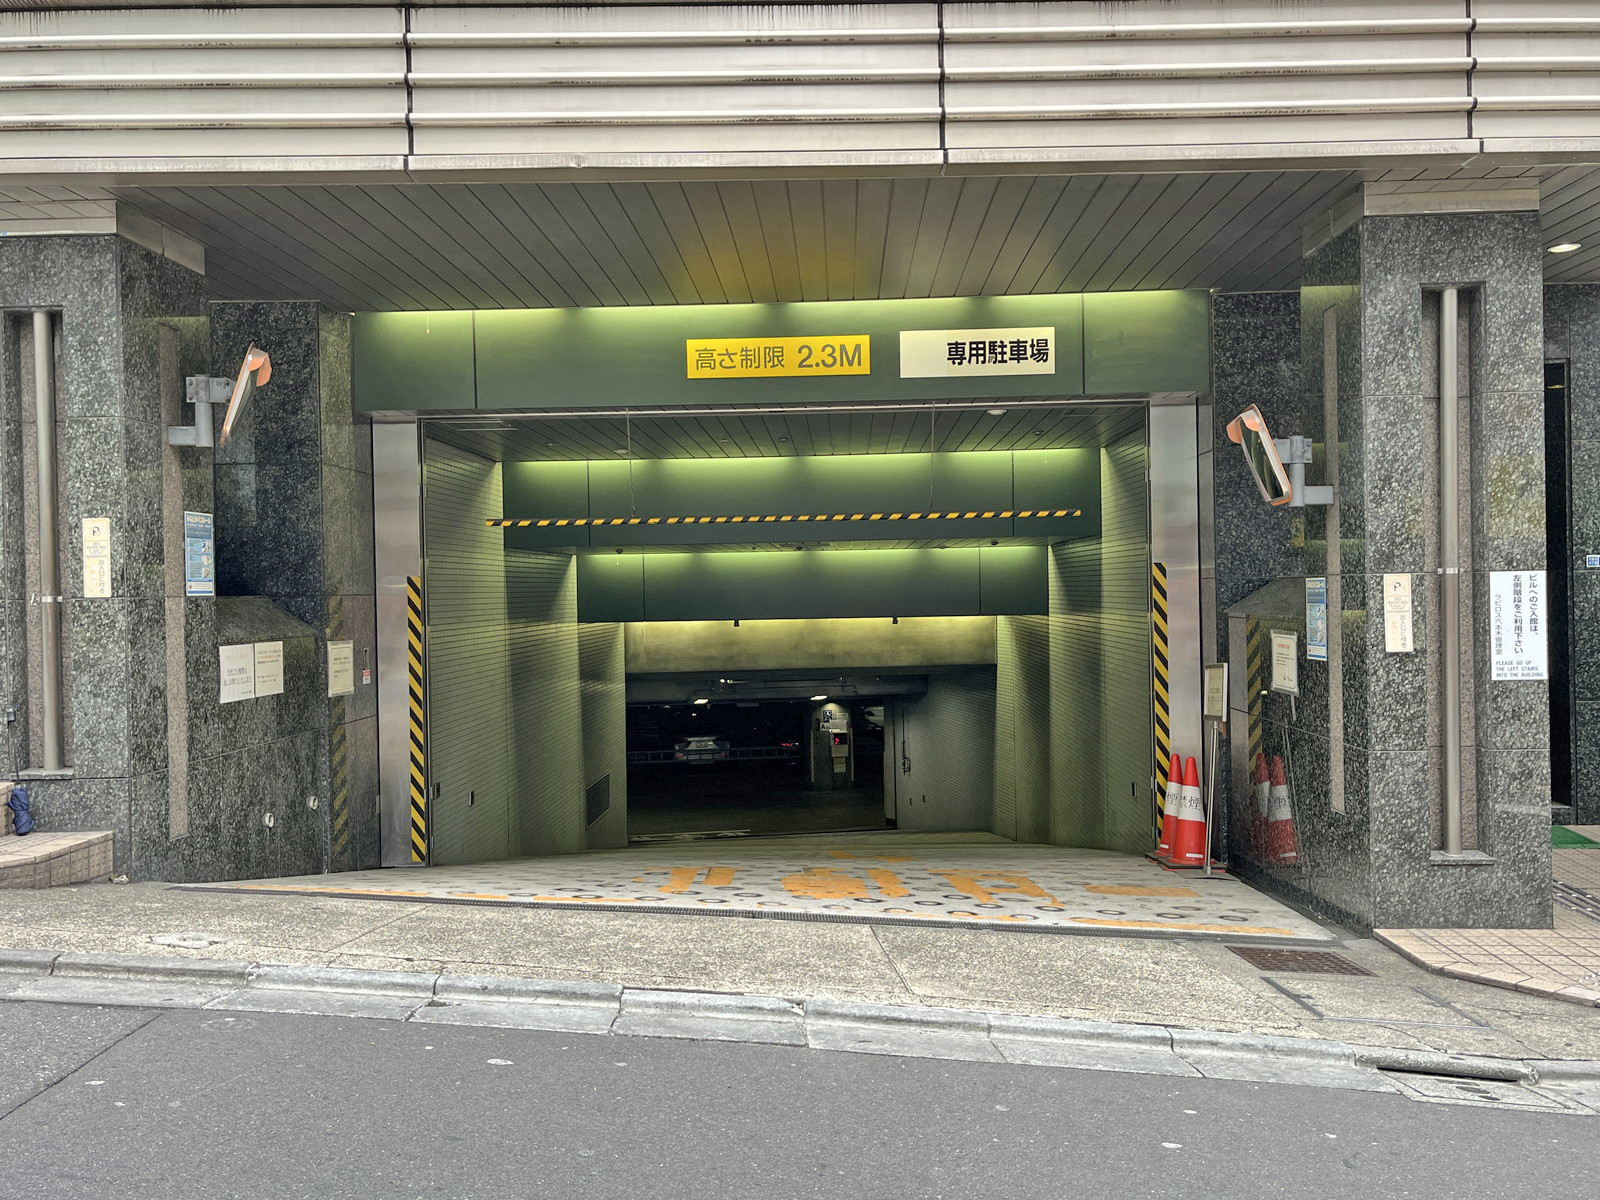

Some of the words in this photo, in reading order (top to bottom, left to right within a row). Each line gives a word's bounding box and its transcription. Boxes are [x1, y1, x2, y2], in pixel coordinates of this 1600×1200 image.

[695, 346, 785, 371] 高さ制限
[797, 344, 862, 369] 2.3M
[946, 338, 1050, 366] 専用駐車場
